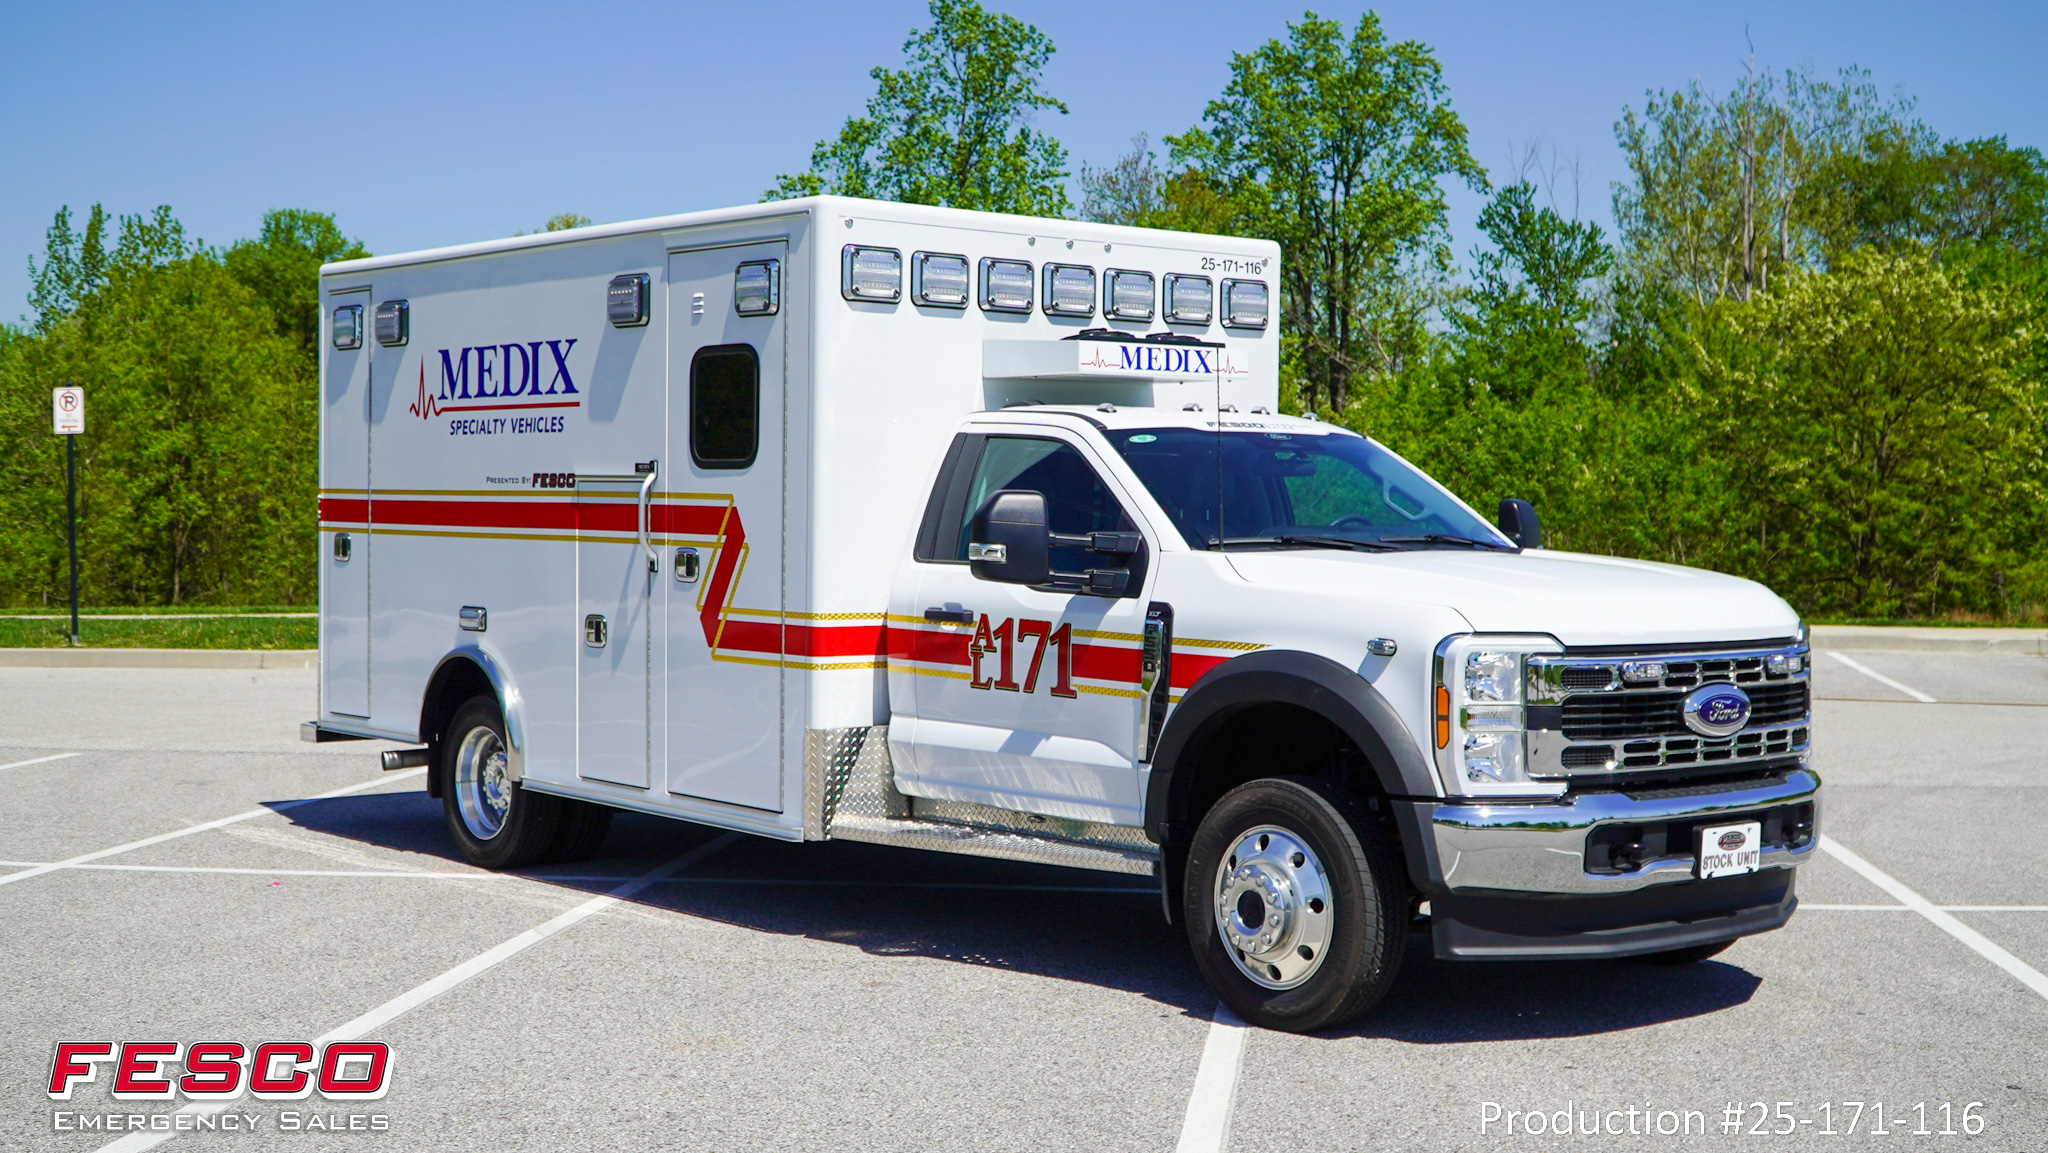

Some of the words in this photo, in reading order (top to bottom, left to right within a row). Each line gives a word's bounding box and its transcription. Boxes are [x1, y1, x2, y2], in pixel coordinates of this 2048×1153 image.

[1201, 256, 1262, 275] 25-171-116
[437, 338, 579, 401] MEDIX
[1119, 345, 1213, 374] MEDIX
[450, 418, 507, 435] SPECIALTY
[511, 416, 564, 434] VEHICLES
[532, 473, 576, 488] FESCO
[1709, 699, 1740, 722] Ford
[1702, 853, 1733, 870] STOCK
[1737, 850, 1759, 866] UNIT
